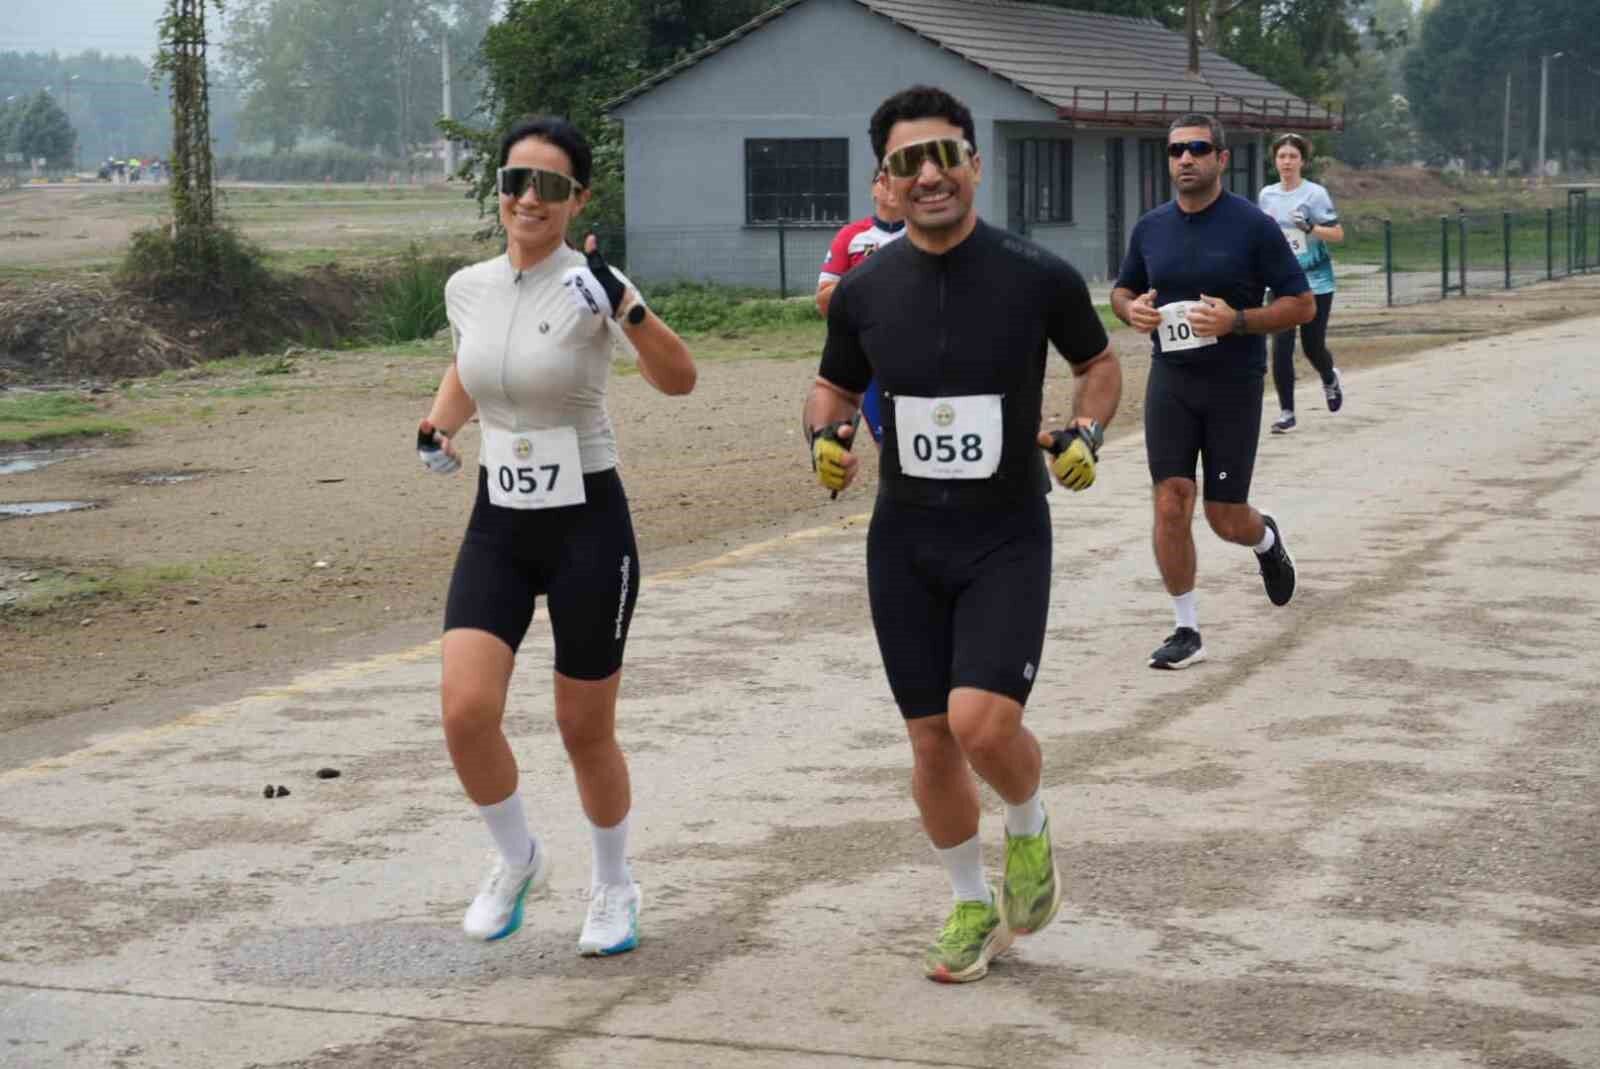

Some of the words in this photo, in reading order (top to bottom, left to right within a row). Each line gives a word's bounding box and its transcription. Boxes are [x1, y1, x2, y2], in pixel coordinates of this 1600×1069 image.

[1168, 323, 1201, 341] 10
[913, 433, 983, 463] 058
[499, 464, 560, 494] 057
